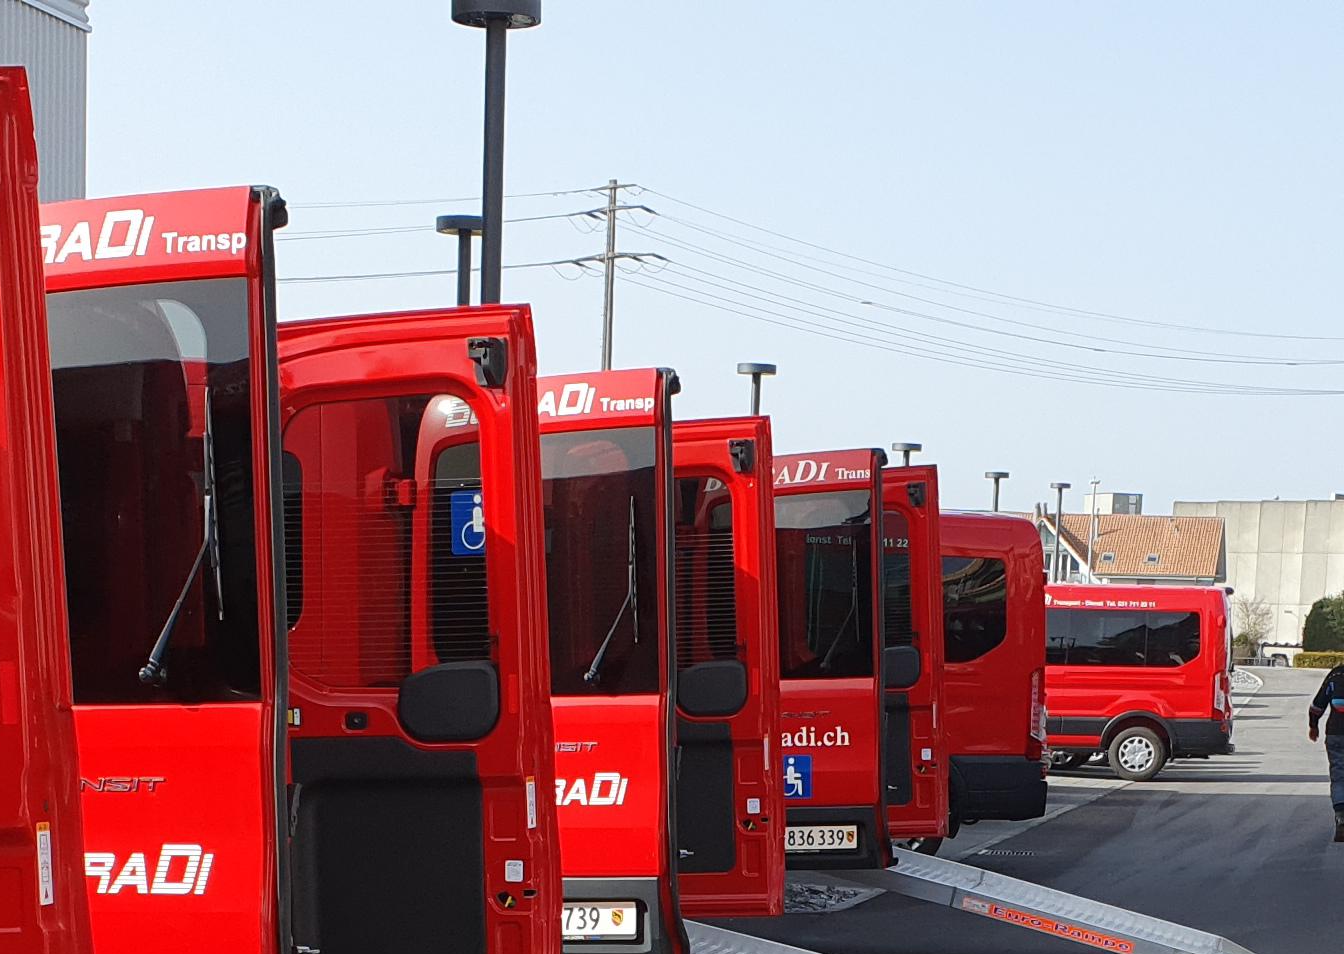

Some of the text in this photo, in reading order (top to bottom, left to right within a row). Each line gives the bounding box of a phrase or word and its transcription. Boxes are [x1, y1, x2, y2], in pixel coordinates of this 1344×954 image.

[161, 231, 247, 255] Transp
[773, 460, 831, 486] ADI
[993, 904, 1131, 951] Euro-Rampe
